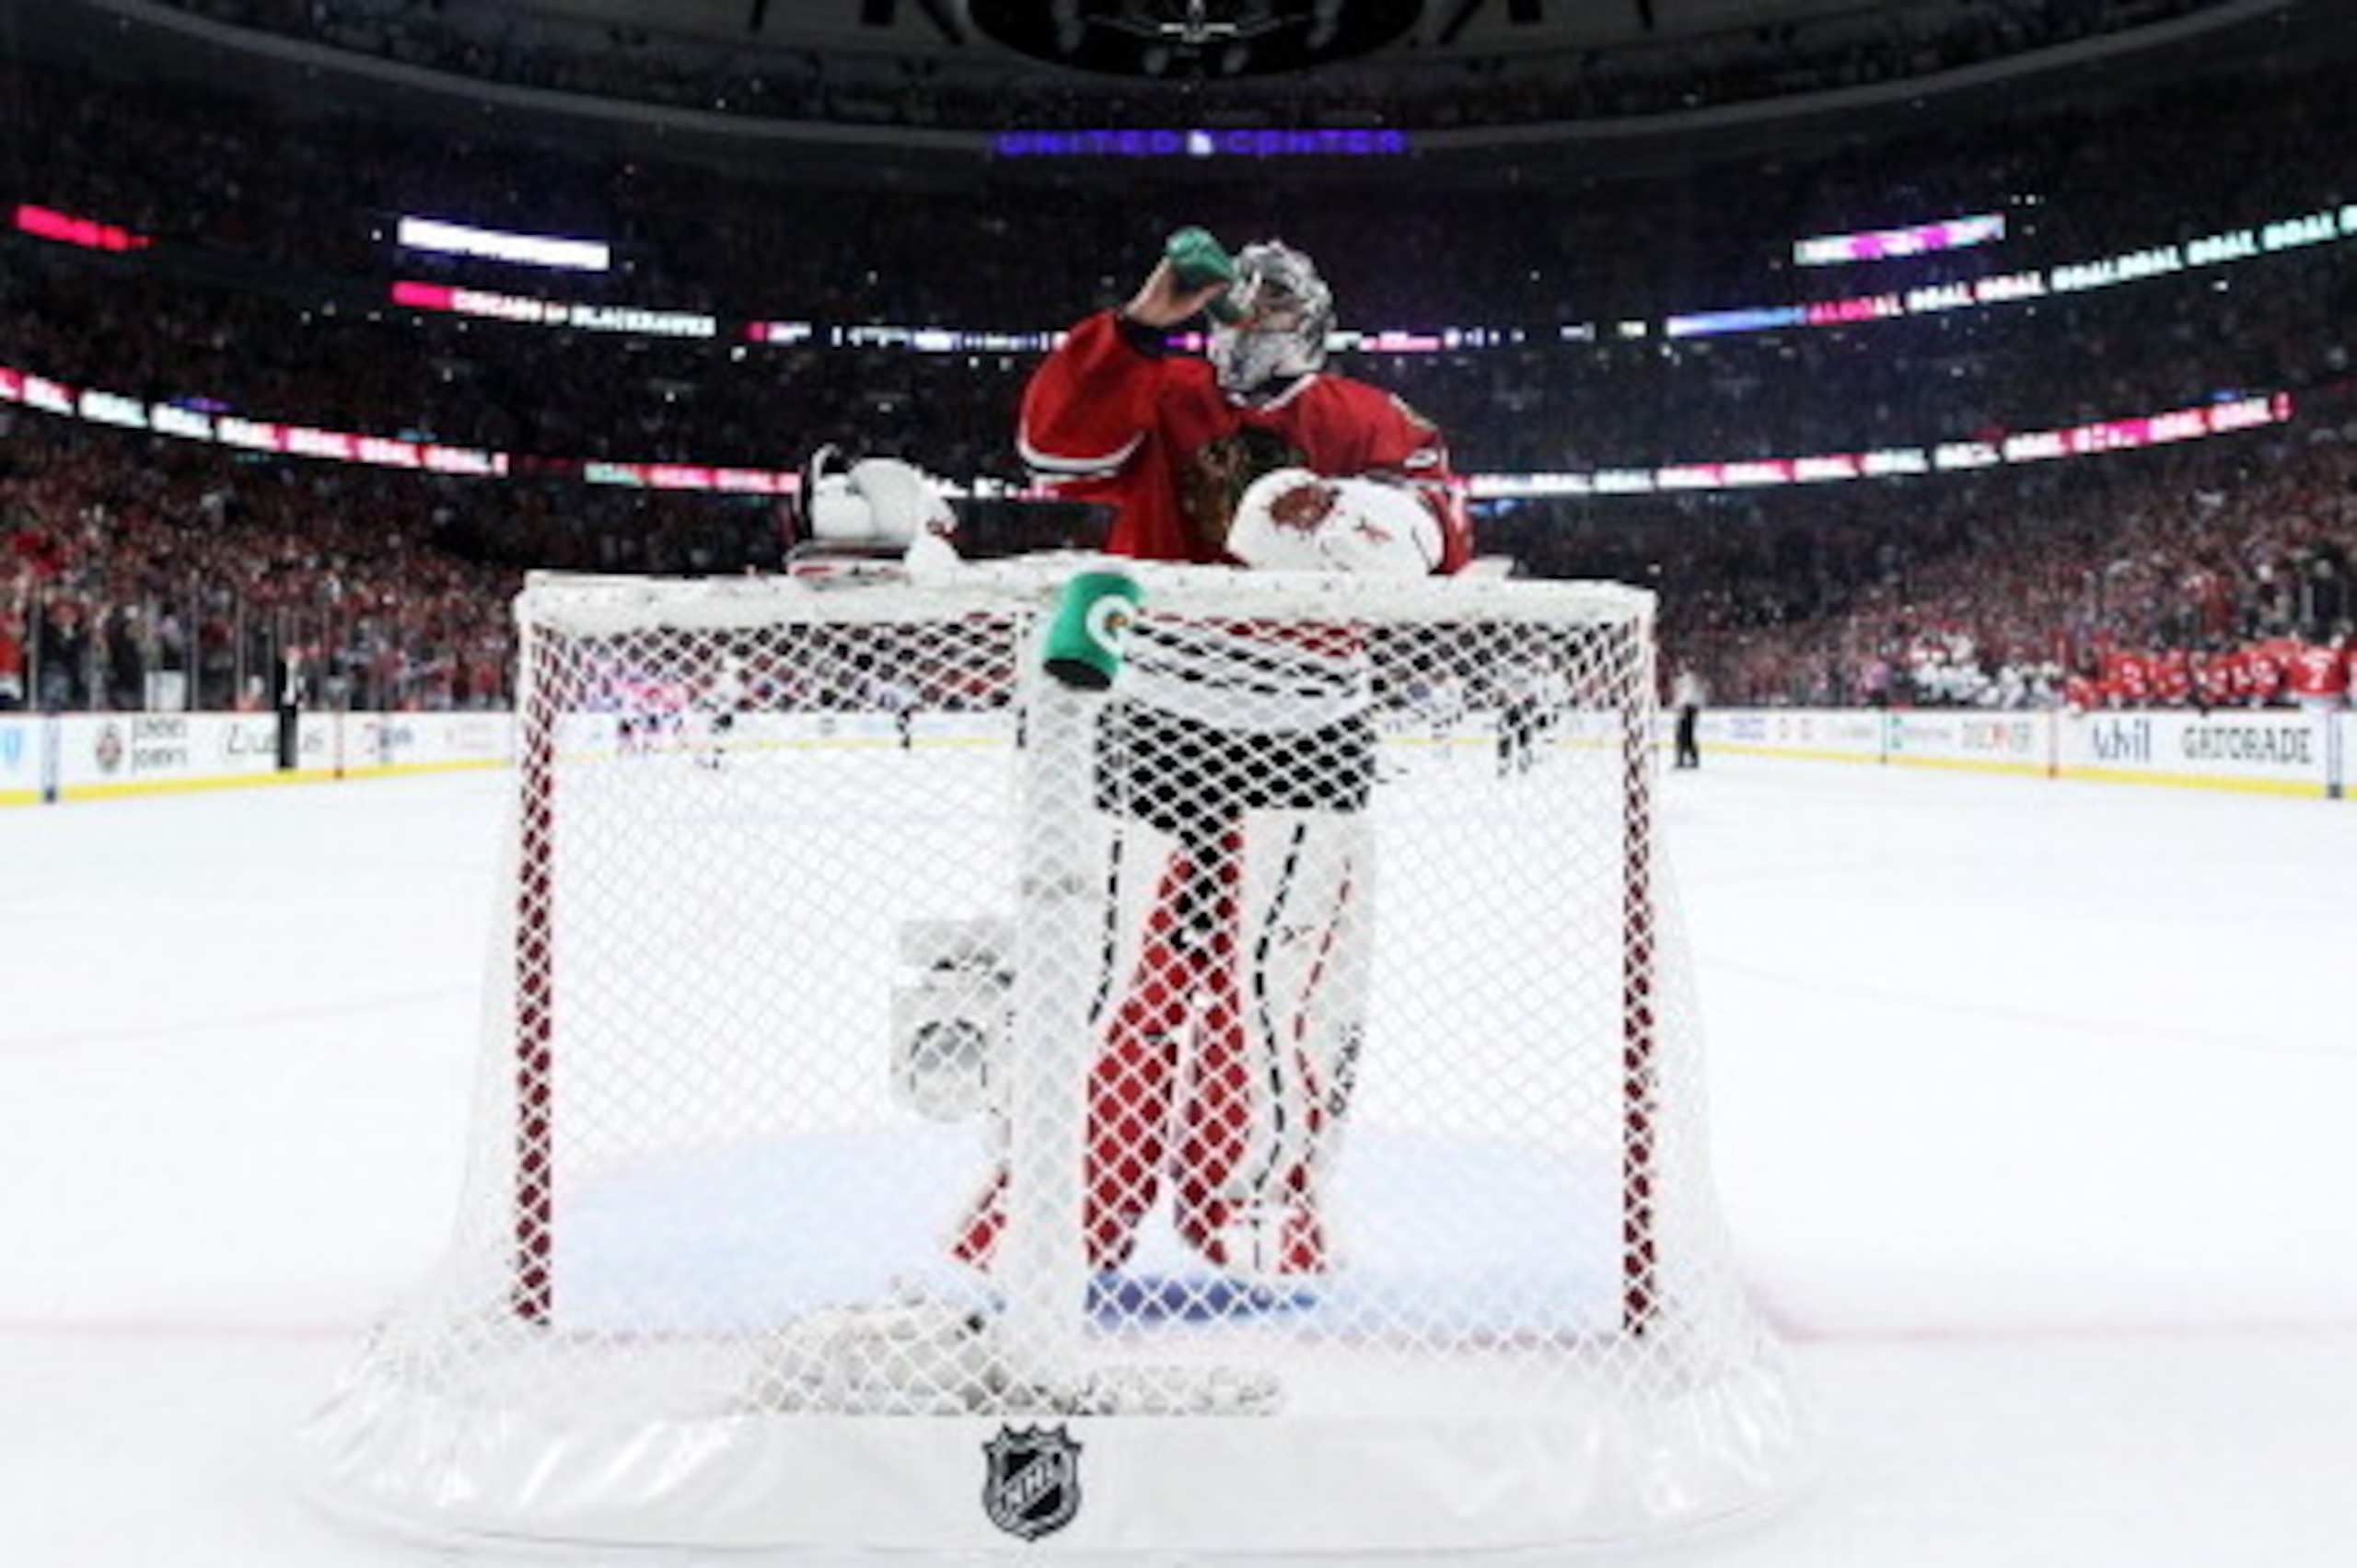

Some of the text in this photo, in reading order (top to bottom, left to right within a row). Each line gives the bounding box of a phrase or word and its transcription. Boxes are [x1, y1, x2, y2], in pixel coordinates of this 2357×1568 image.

[997, 129, 1404, 154] UNITED CENTER
[2181, 726, 2314, 764] GATORADE
